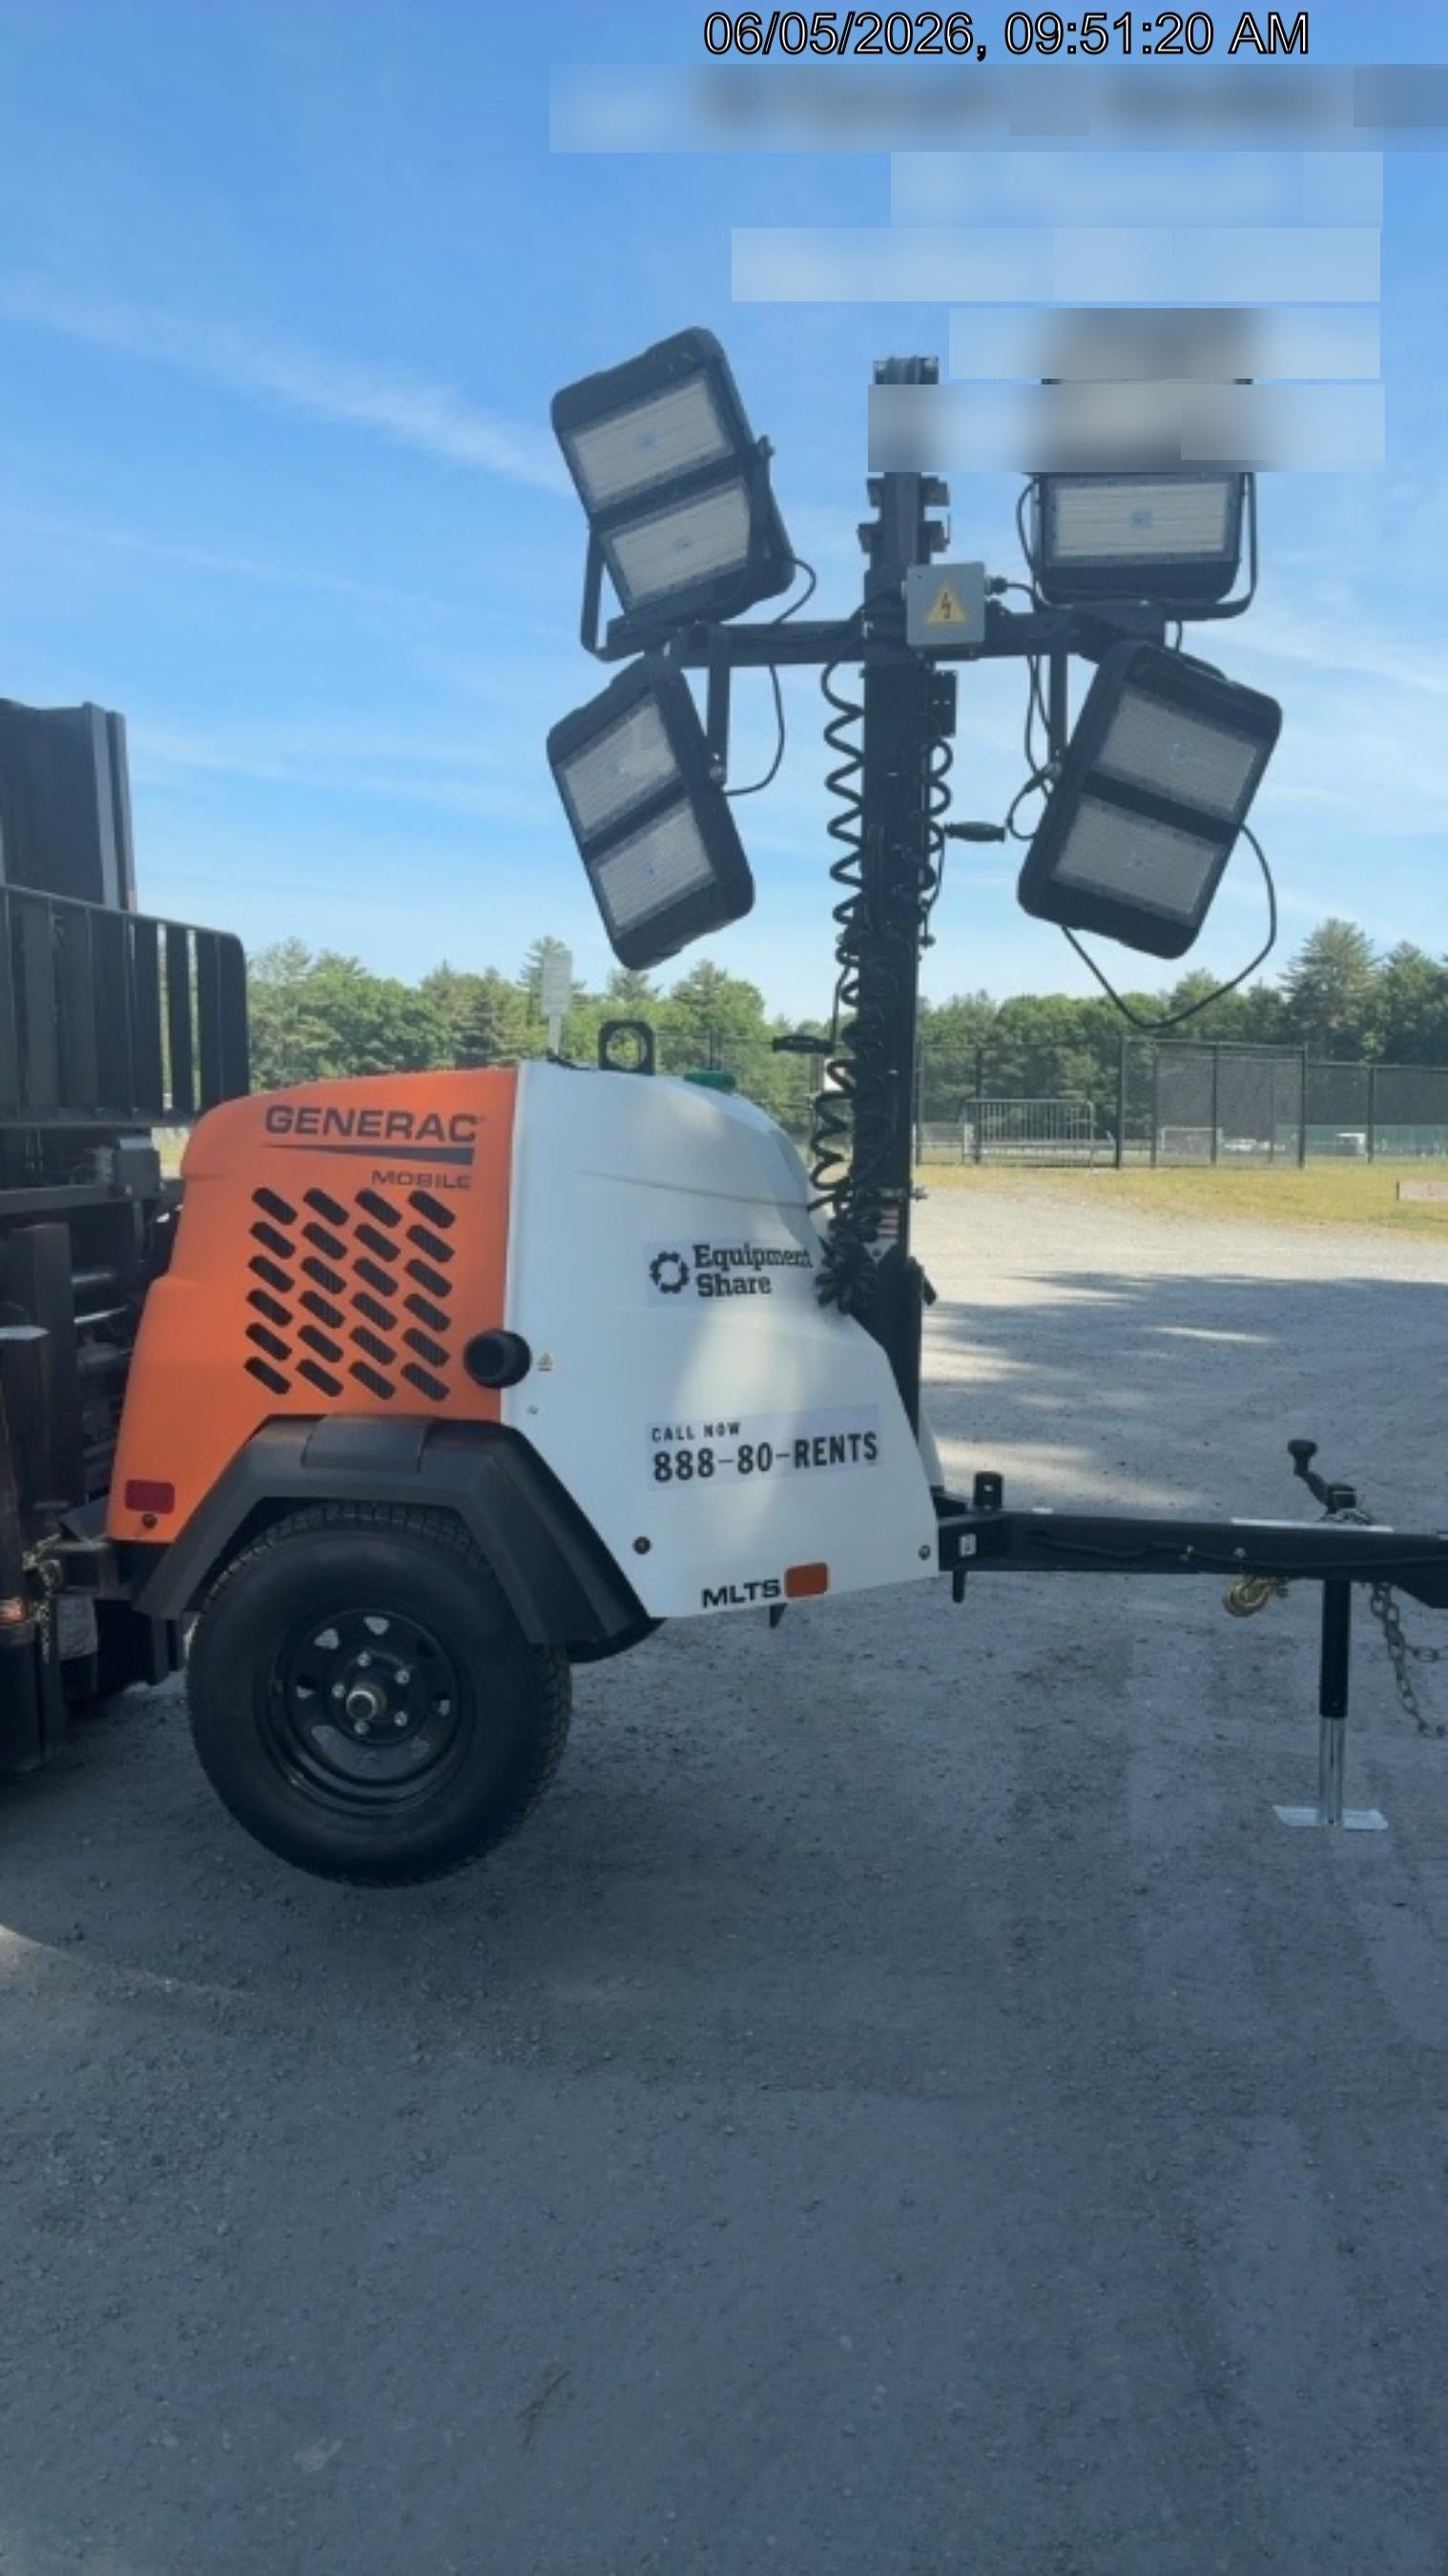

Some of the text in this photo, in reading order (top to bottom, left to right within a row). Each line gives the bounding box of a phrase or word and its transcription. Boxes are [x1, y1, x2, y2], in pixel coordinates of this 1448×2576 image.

[265, 1105, 476, 1143] GENERAC
[371, 1170, 472, 1190] MOBILE
[693, 1242, 814, 1272] Equipment
[696, 1273, 773, 1298] Share
[652, 1422, 742, 1443] CALL NOW
[653, 1431, 879, 1483] 888-80-RENTS
[702, 1578, 780, 1609] MLTS
